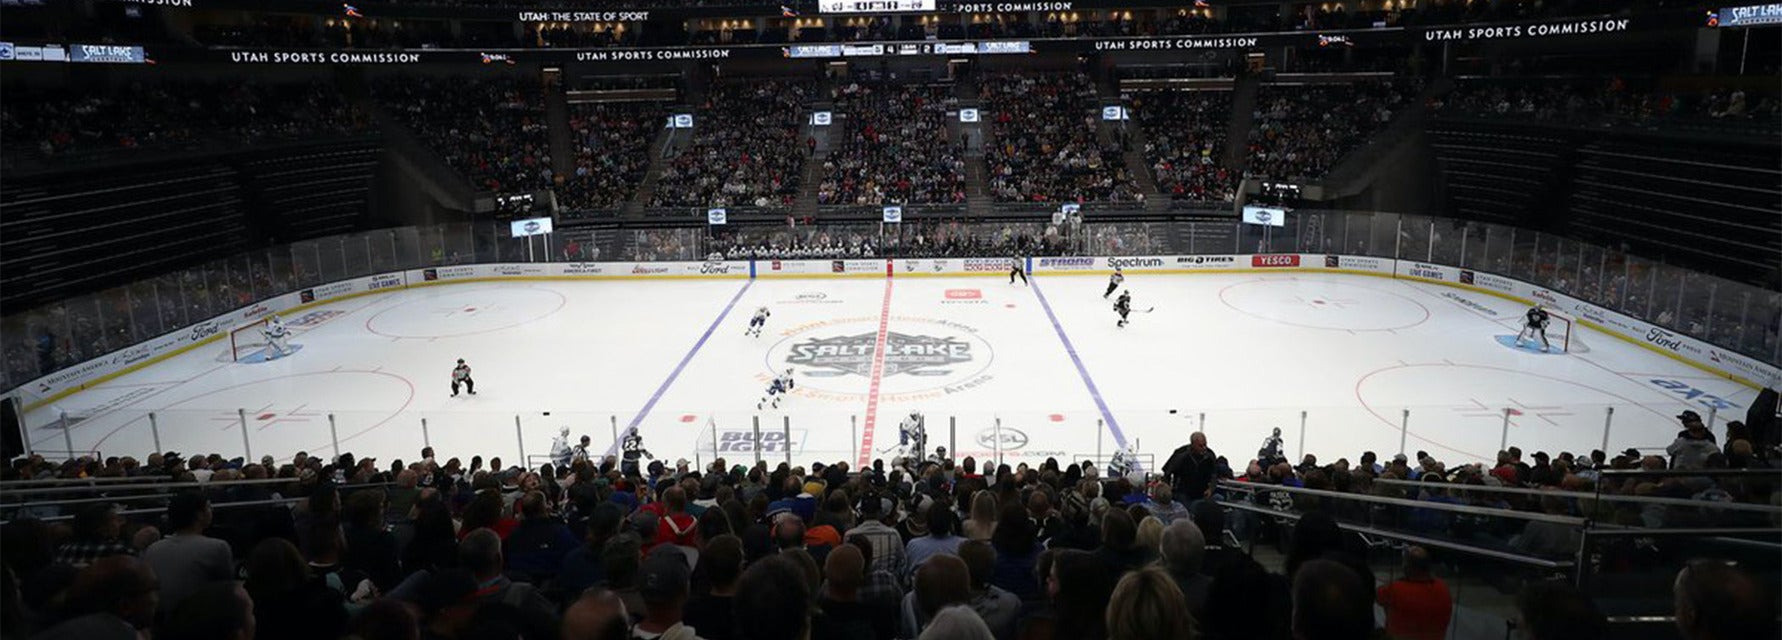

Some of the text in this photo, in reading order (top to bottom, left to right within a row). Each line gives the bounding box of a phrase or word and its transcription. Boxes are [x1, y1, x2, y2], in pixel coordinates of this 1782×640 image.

[997, 2, 1071, 13] COMMISSION
[1731, 3, 1782, 23] SALT LAK
[519, 11, 649, 22] UTAH: THE STATE OF SPORT
[1425, 20, 1630, 41] UTAH SPORTS COMMISSION
[1095, 38, 1257, 50] UTAH SPORTS COMMISSION
[82, 45, 133, 61] SALT LAKE
[232, 52, 420, 63] UTAH SPORTS COMMISSION
[577, 49, 730, 61] UTAH SPORTS COMMISSION
[700, 261, 730, 274] Ford
[1107, 257, 1162, 270] Spectrum
[1260, 257, 1293, 266] YESCO
[190, 322, 219, 341] Ford
[1646, 327, 1682, 352] Ford
[793, 344, 876, 361] SALT
[884, 343, 969, 359] LAKE
[1718, 352, 1755, 370] MOUNTAIN
[720, 431, 788, 442] BUD
[980, 433, 1022, 443] KSL
